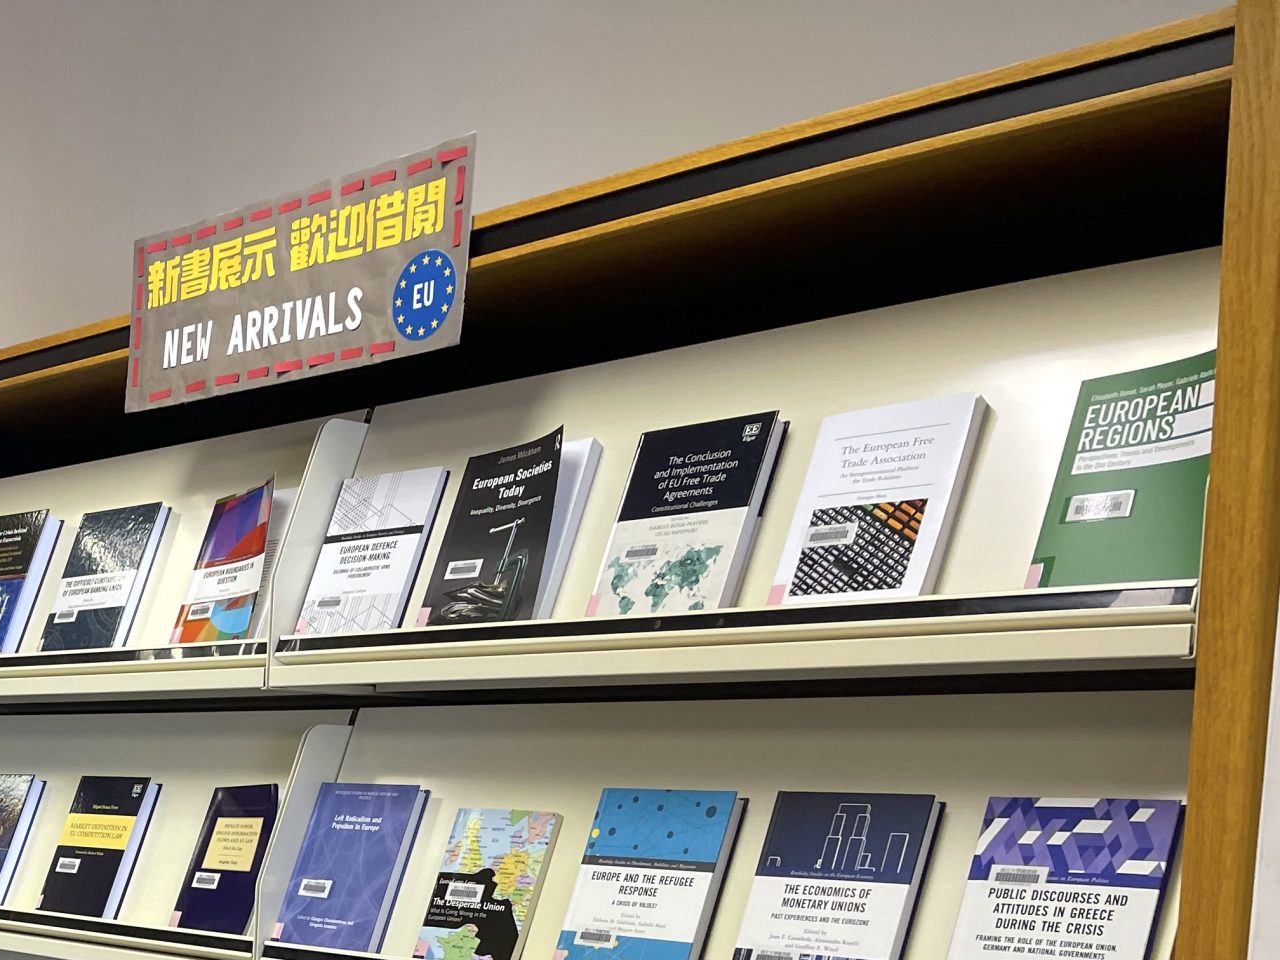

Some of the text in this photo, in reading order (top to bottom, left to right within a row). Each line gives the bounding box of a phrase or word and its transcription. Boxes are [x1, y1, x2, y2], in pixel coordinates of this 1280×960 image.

[147, 226, 278, 309] 新書展示
[412, 280, 435, 310] EU
[162, 287, 363, 369] NEW ARRIVALS
[1084, 385, 1200, 428] EUROPEAN
[1077, 416, 1174, 451] REGIONS
[841, 436, 935, 456] The European Free
[669, 449, 732, 465] The Conclusion
[840, 451, 926, 469] Trade Association
[472, 460, 553, 491] European Societies
[654, 460, 739, 479] and Implementation
[658, 472, 727, 489] of EU Free Trade
[498, 484, 525, 500] Today
[663, 487, 713, 501] Agreements
[591, 871, 695, 887] EUROPE AND THE REFUGEE
[618, 886, 658, 897] RESPONSE
[784, 884, 872, 899] THE ECONOMICS OF
[988, 888, 1128, 906] PUBLIC DISCOURSES AND
[433, 898, 505, 912] The Desperate Union
[781, 898, 866, 913] MONETARY UNIONS
[993, 903, 1115, 921] ATTITUDES IN GREECE
[995, 918, 1104, 936] DURING THE CRISIS
